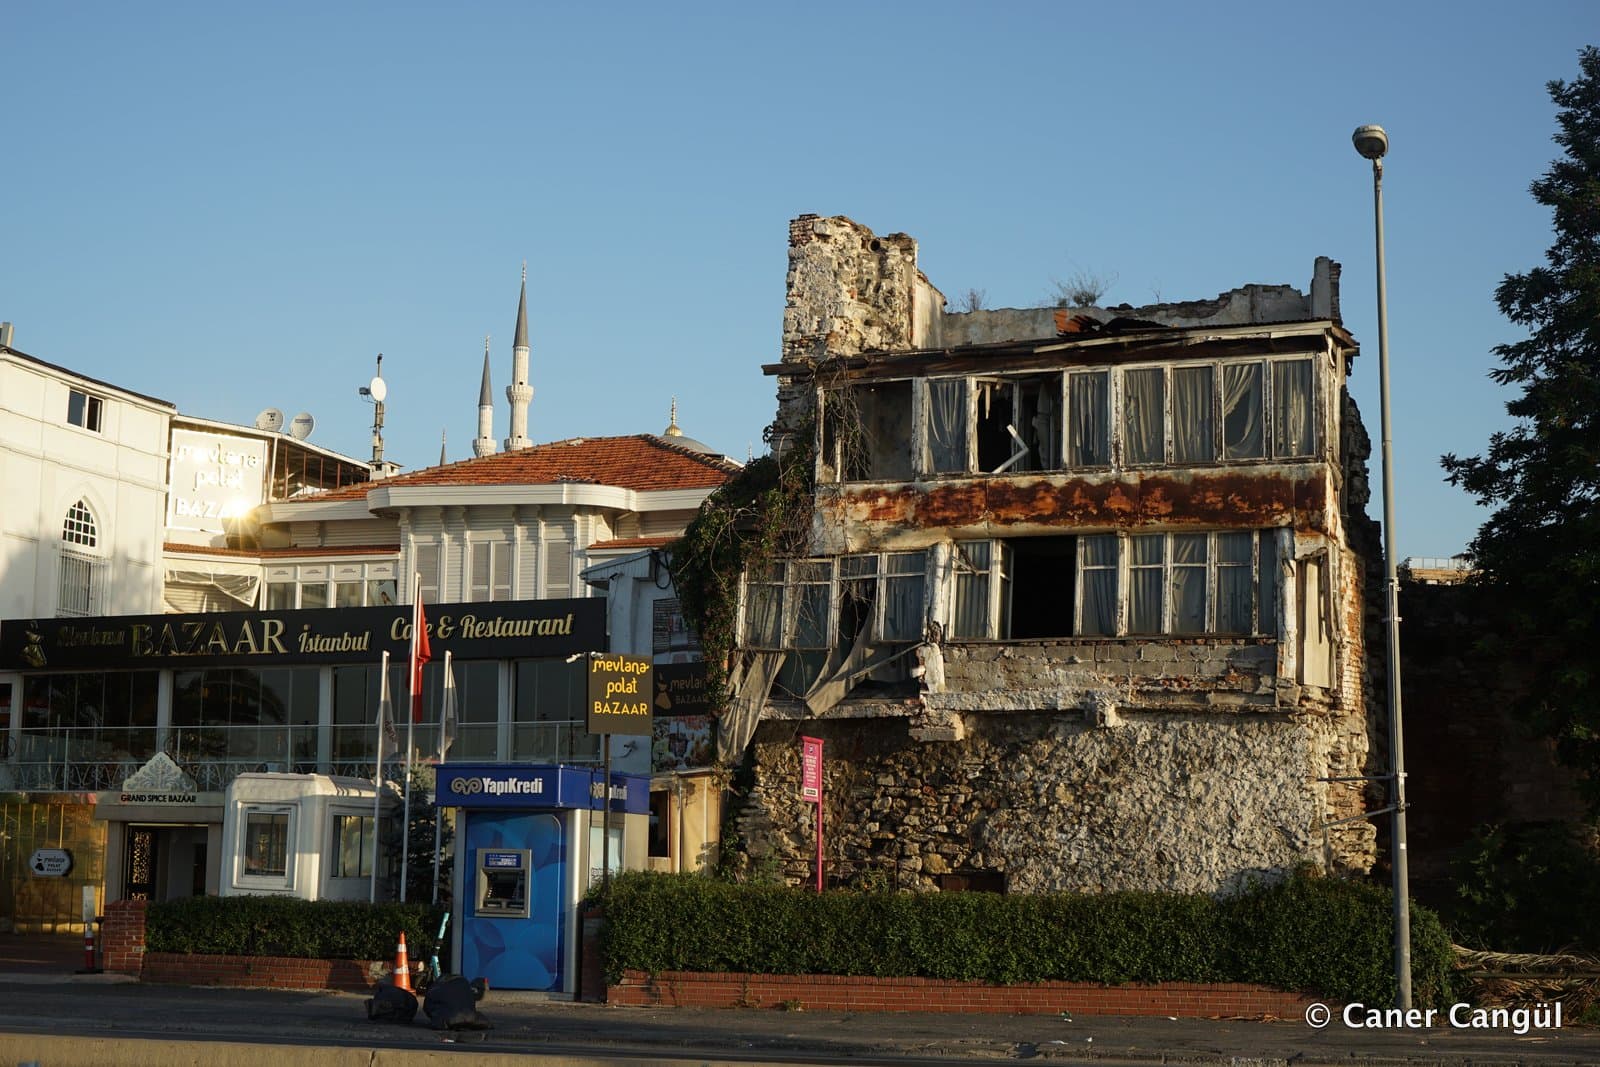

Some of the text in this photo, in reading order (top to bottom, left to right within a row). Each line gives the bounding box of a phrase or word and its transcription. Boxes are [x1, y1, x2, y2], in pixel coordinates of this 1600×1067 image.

[130, 619, 288, 656] BAZAAR
[390, 616, 433, 641] Cae
[437, 614, 455, 640] &
[459, 613, 576, 639] Restaurant
[592, 656, 650, 675] mevlana
[605, 677, 638, 699] polat
[594, 701, 648, 715] BAZAAR
[482, 777, 543, 796] YapıKredi
[121, 794, 197, 803] GRAND SPICE BAZAAR
